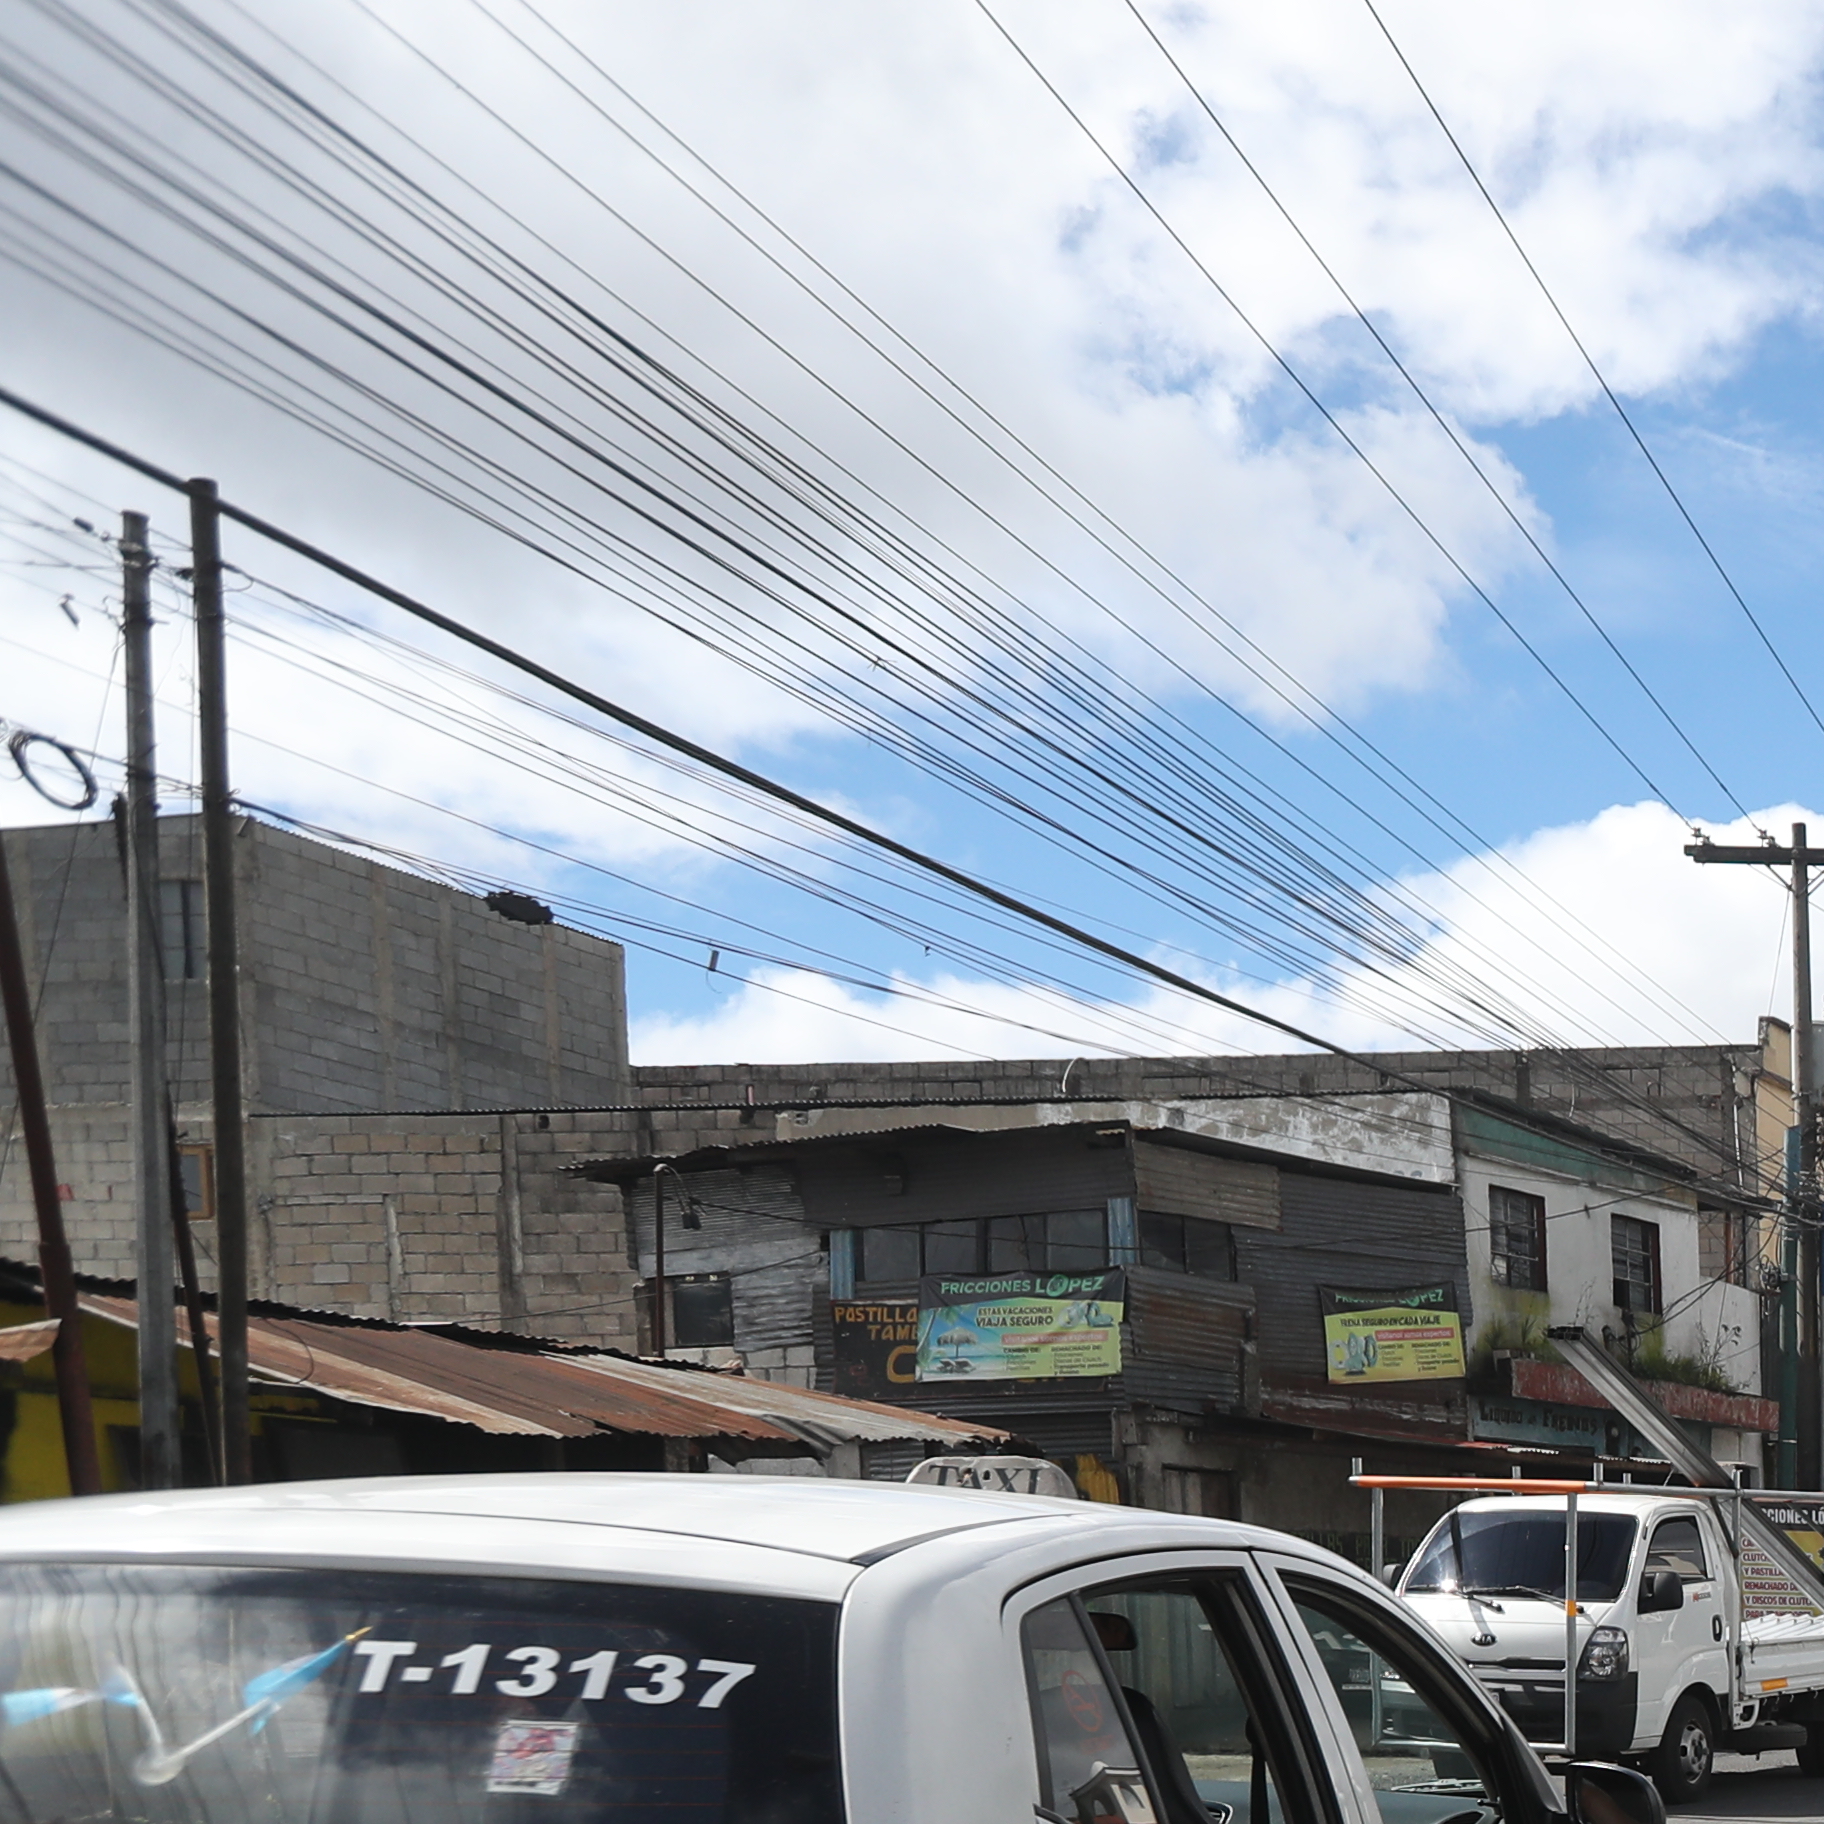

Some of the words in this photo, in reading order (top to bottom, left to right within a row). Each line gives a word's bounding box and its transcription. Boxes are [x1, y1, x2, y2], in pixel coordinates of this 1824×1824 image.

[941, 1279, 1031, 1294] FRICCIONES
[978, 1306, 1001, 1316] ESTAS
[1002, 1305, 1053, 1315] VACACIONES
[975, 1316, 1008, 1328] VIAJA
[1010, 1315, 1053, 1327] SEGURO
[1745, 1581, 1788, 1591] REMACHADO
[1752, 1596, 1777, 1605] DISCOS
[1778, 1597, 1787, 1605] DE
[354, 1640, 757, 1709] T-13137
